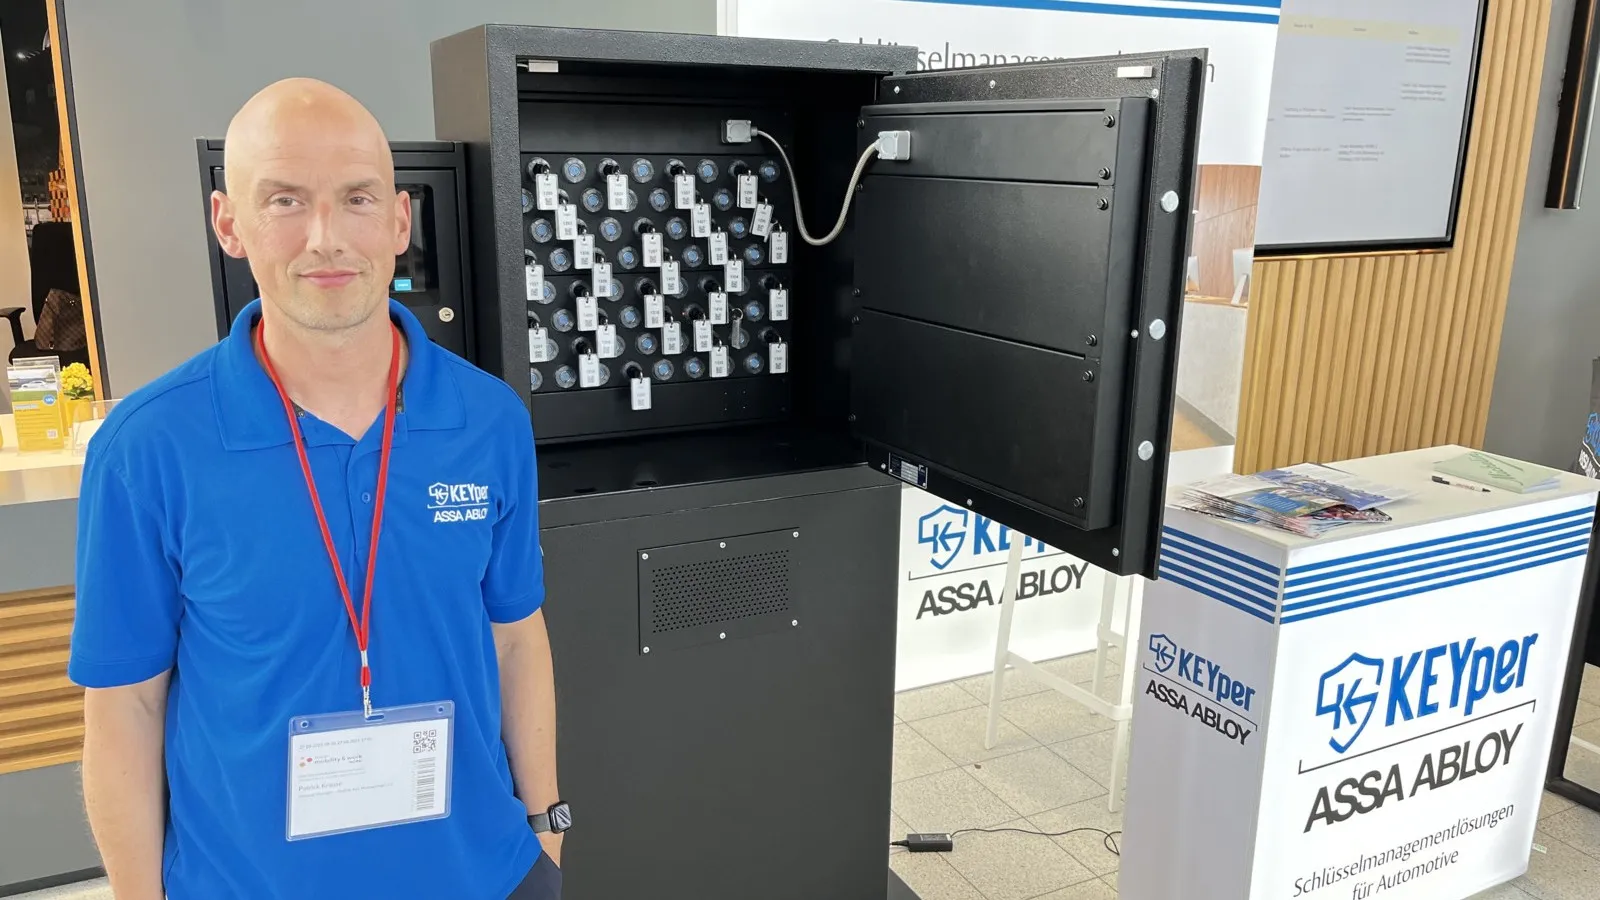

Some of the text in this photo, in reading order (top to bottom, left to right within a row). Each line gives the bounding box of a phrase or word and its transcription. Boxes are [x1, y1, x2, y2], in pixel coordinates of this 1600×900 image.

[433, 510, 464, 523] ASSA
[916, 580, 994, 620] ASSA
[1178, 648, 1256, 711] KEYper
[1385, 633, 1539, 727] KEYper
[1145, 679, 1252, 746] ASSA ABLOY
[1303, 722, 1524, 834] ASSA ABLOY
[1293, 804, 1514, 897] Schlüsselmanagementlösungen
[1352, 849, 1459, 900] für Automotive
